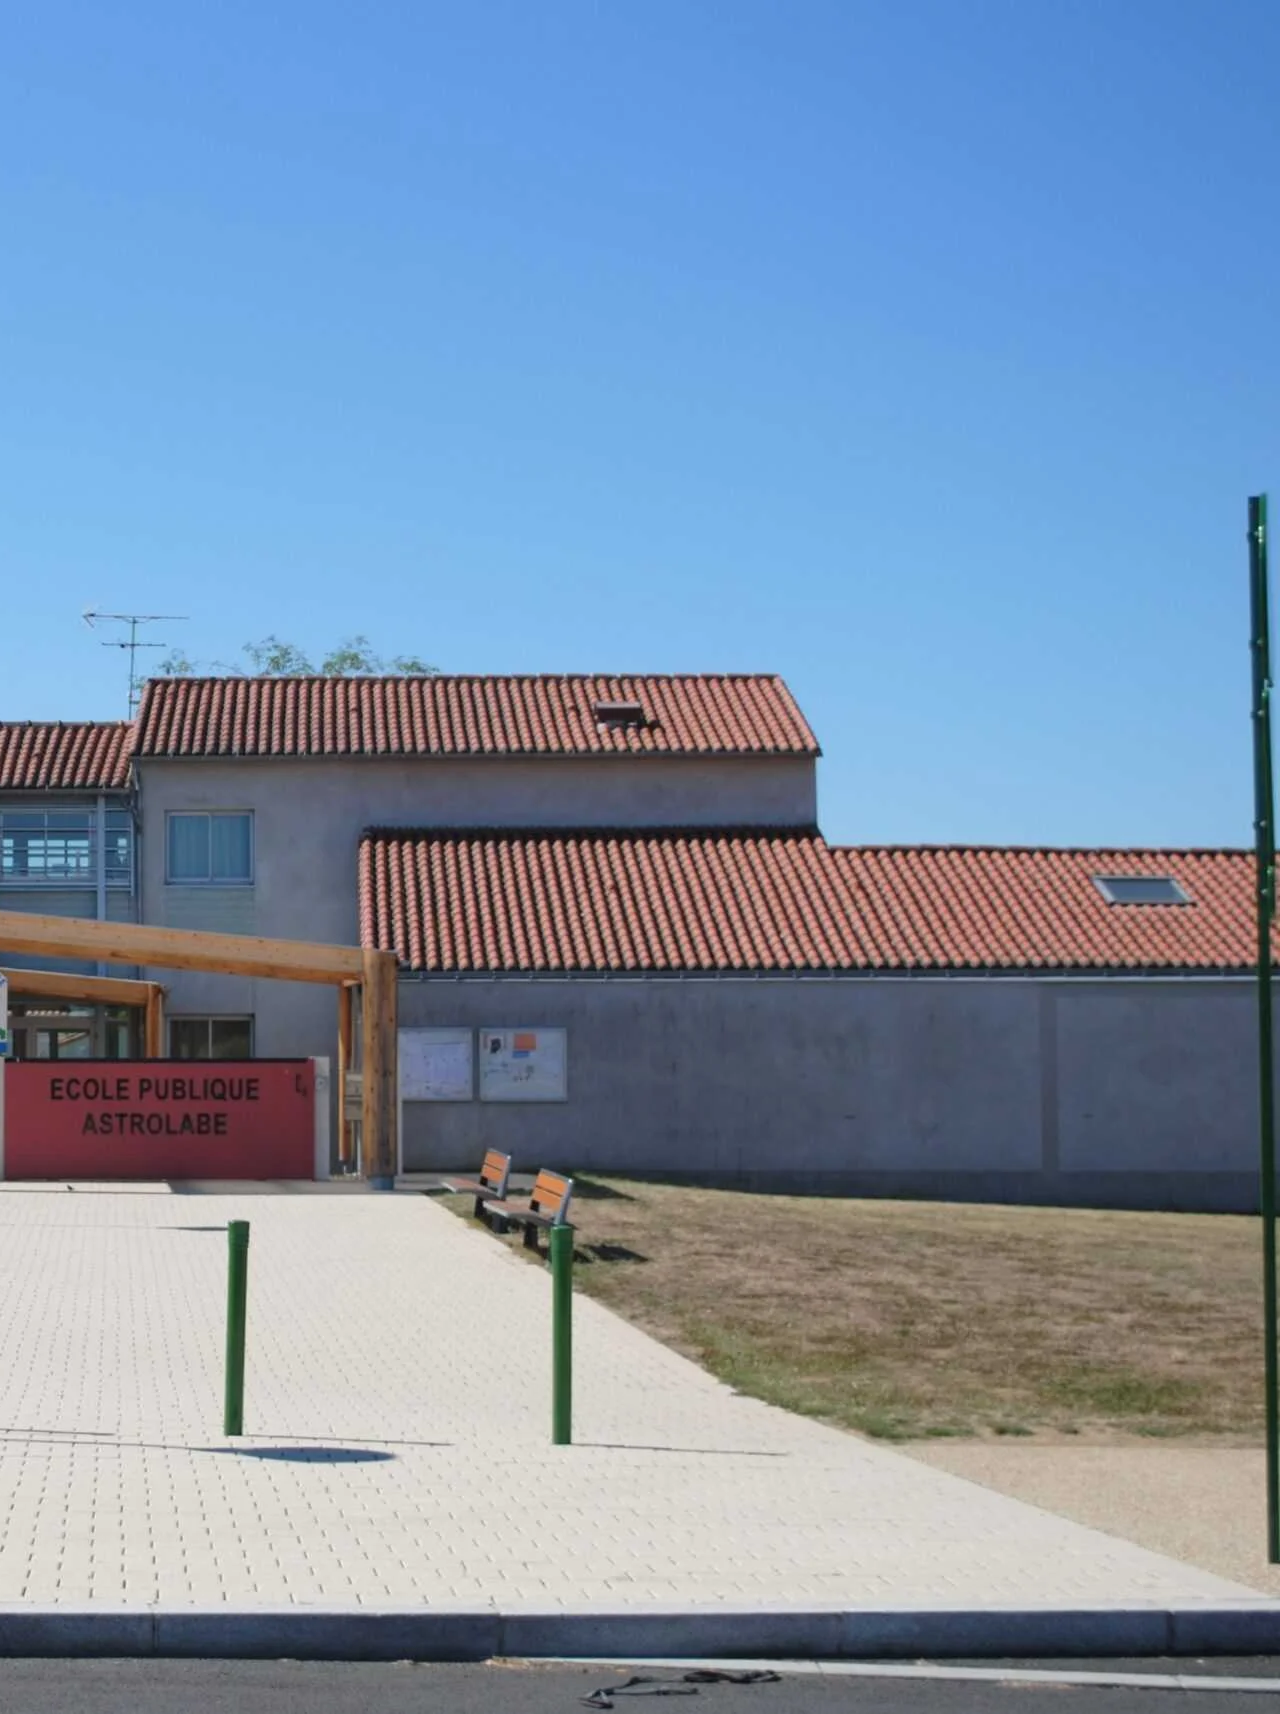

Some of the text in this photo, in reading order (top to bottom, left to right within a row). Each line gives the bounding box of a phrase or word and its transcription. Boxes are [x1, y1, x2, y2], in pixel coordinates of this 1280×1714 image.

[50, 1078, 260, 1101] ECOLE PUBLIQUE
[82, 1112, 228, 1135] ASTROLABE
